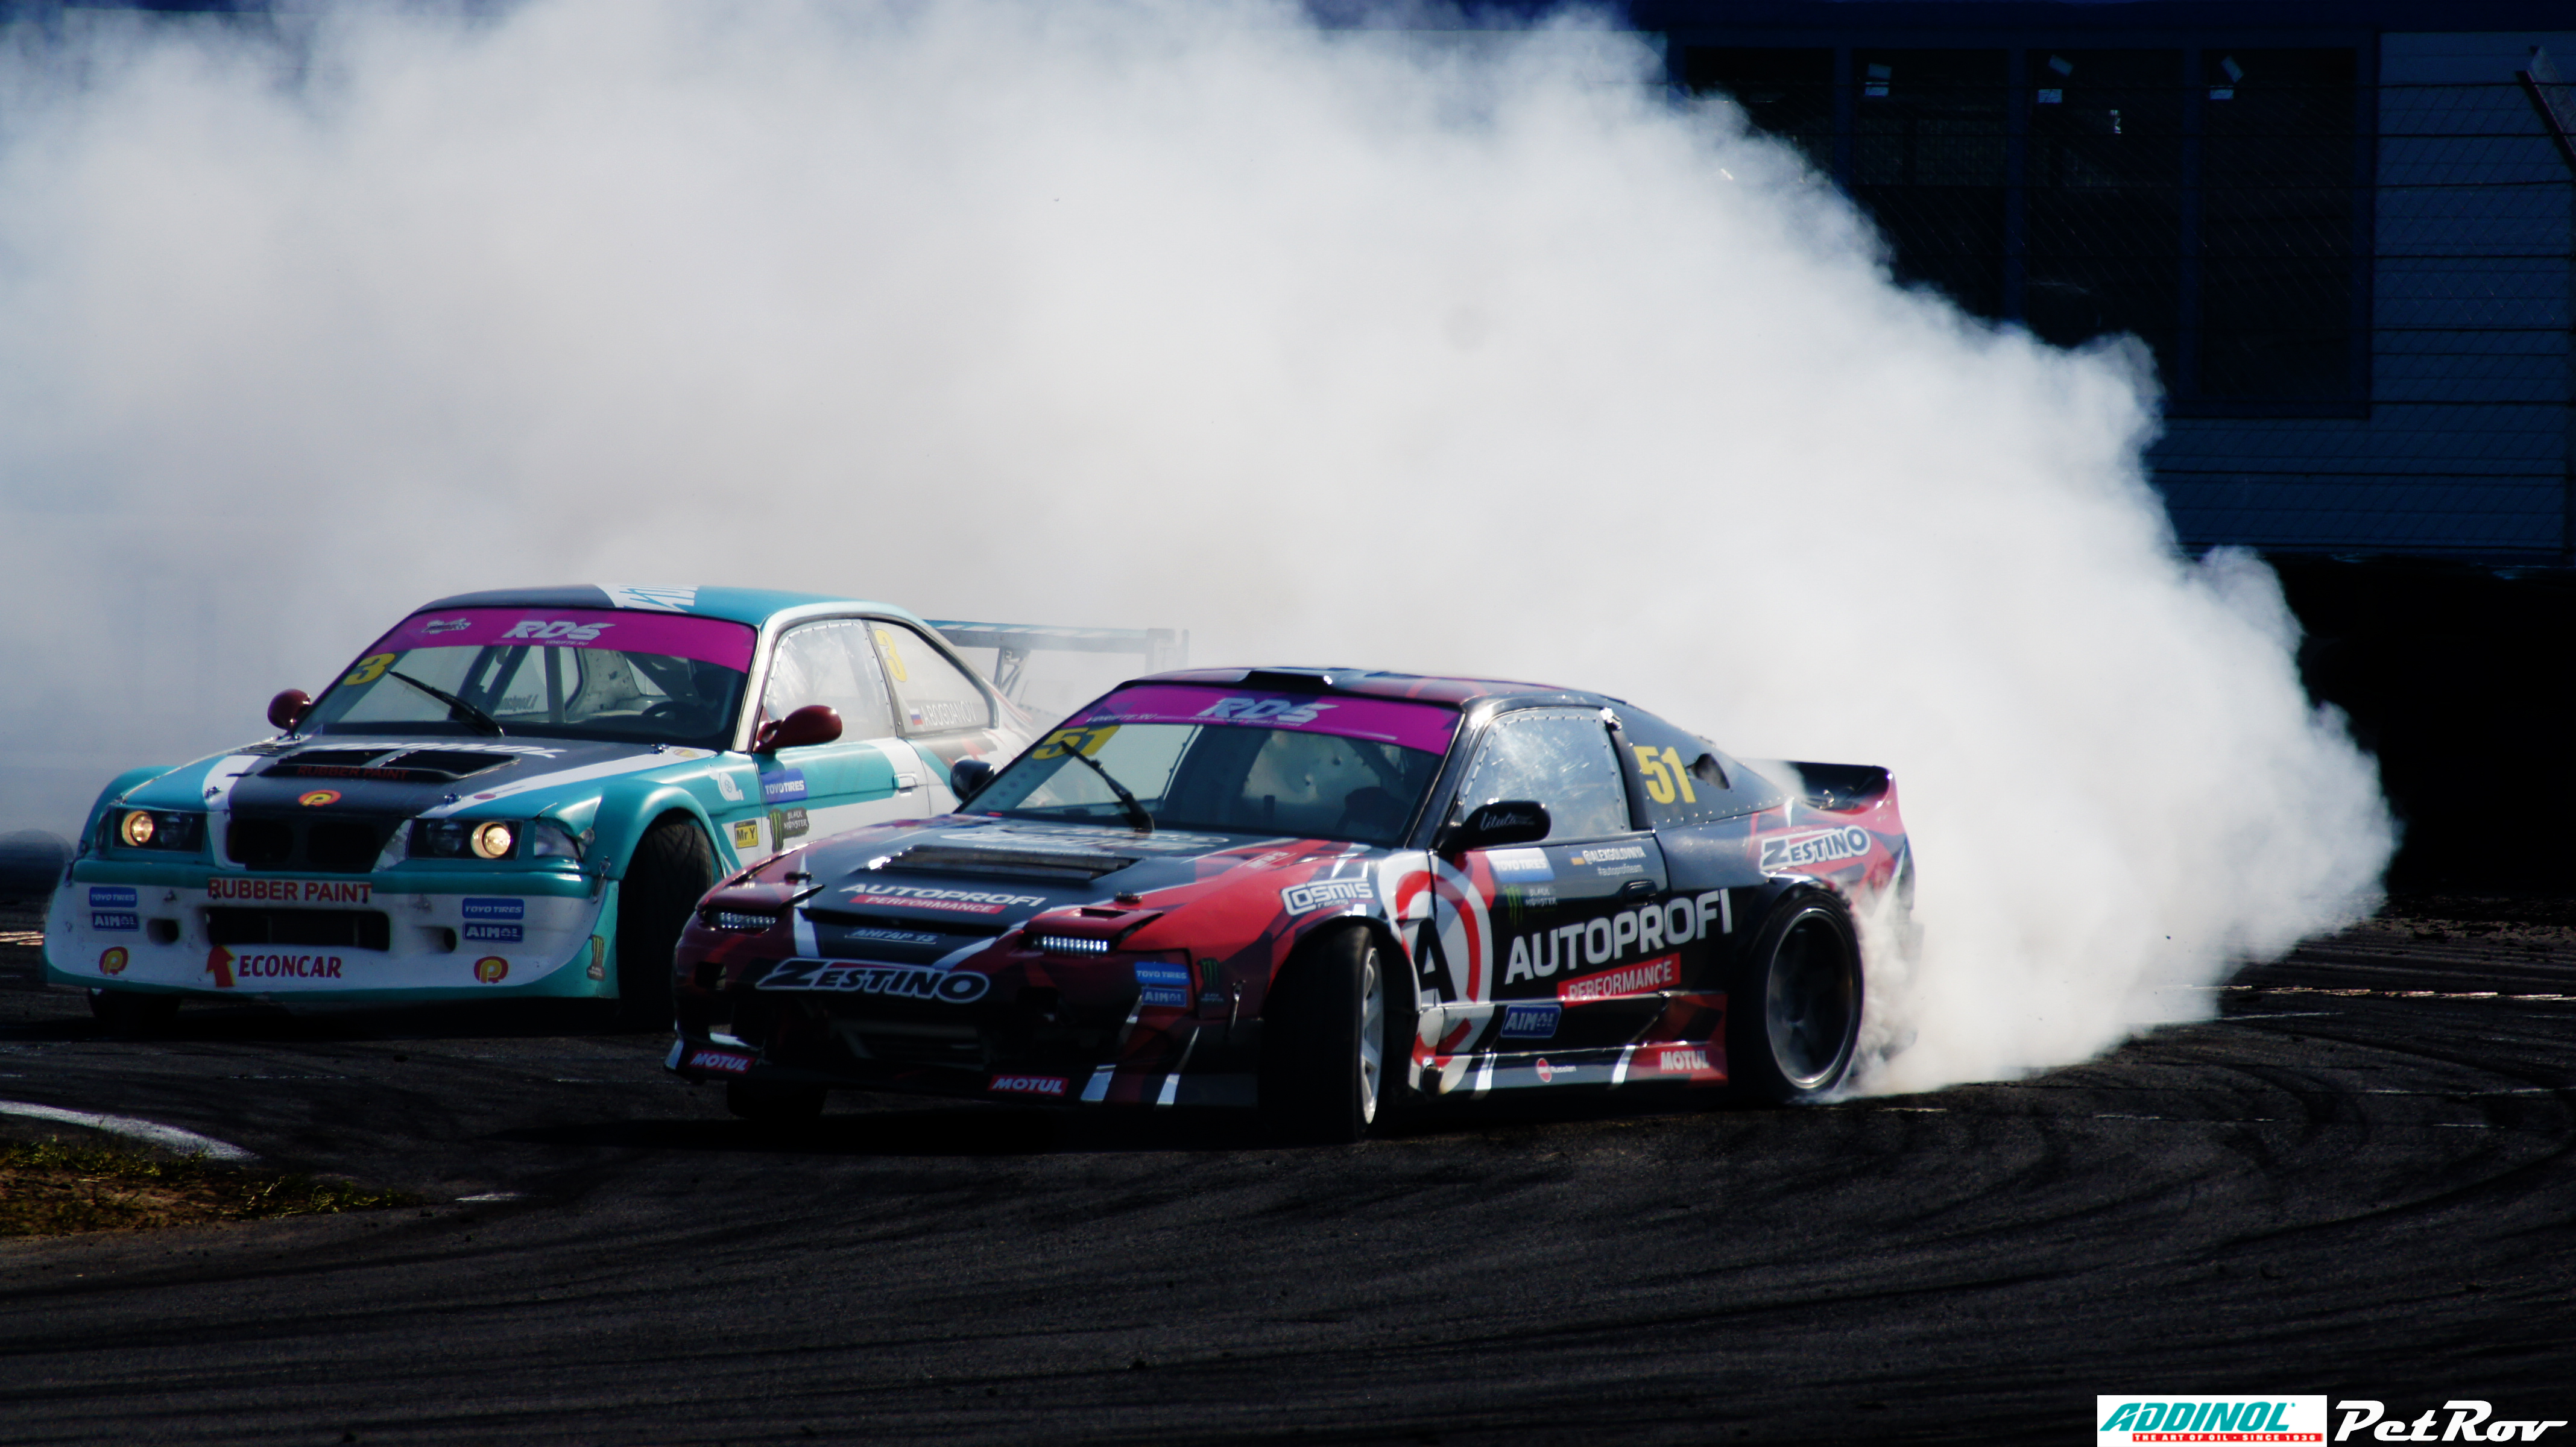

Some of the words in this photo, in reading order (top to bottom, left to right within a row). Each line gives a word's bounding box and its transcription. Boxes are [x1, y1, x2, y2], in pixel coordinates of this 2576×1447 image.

[500, 620, 617, 640] RDS
[874, 629, 907, 682] 3
[341, 653, 397, 686] 3
[1196, 697, 1339, 723] RDS
[1031, 724, 1122, 760] 51
[297, 765, 360, 778] RUBBER
[362, 768, 409, 781] PAINT
[1634, 746, 1696, 804] 51
[765, 784, 784, 795] TOYO
[783, 780, 805, 793] TIRES
[736, 830, 748, 841] Mr
[749, 827, 756, 839] Y
[1495, 860, 1520, 871] TOYO
[1520, 859, 1547, 870] TIRES
[207, 878, 298, 901] RUBBER
[305, 882, 373, 904] PAINT
[839, 883, 1046, 907] AUTOPROFI
[865, 896, 996, 913] PERFORMANCE
[1504, 889, 1732, 985] AUTOPROFI
[238, 954, 342, 979] ECONCAR
[757, 959, 989, 1003] ZESTINO
[1568, 960, 1672, 1000] PERFORMANCE
[690, 1051, 748, 1072] MOTUL
[1660, 1049, 1710, 1071] MOTUL
[993, 1077, 1063, 1094] MOTUL
